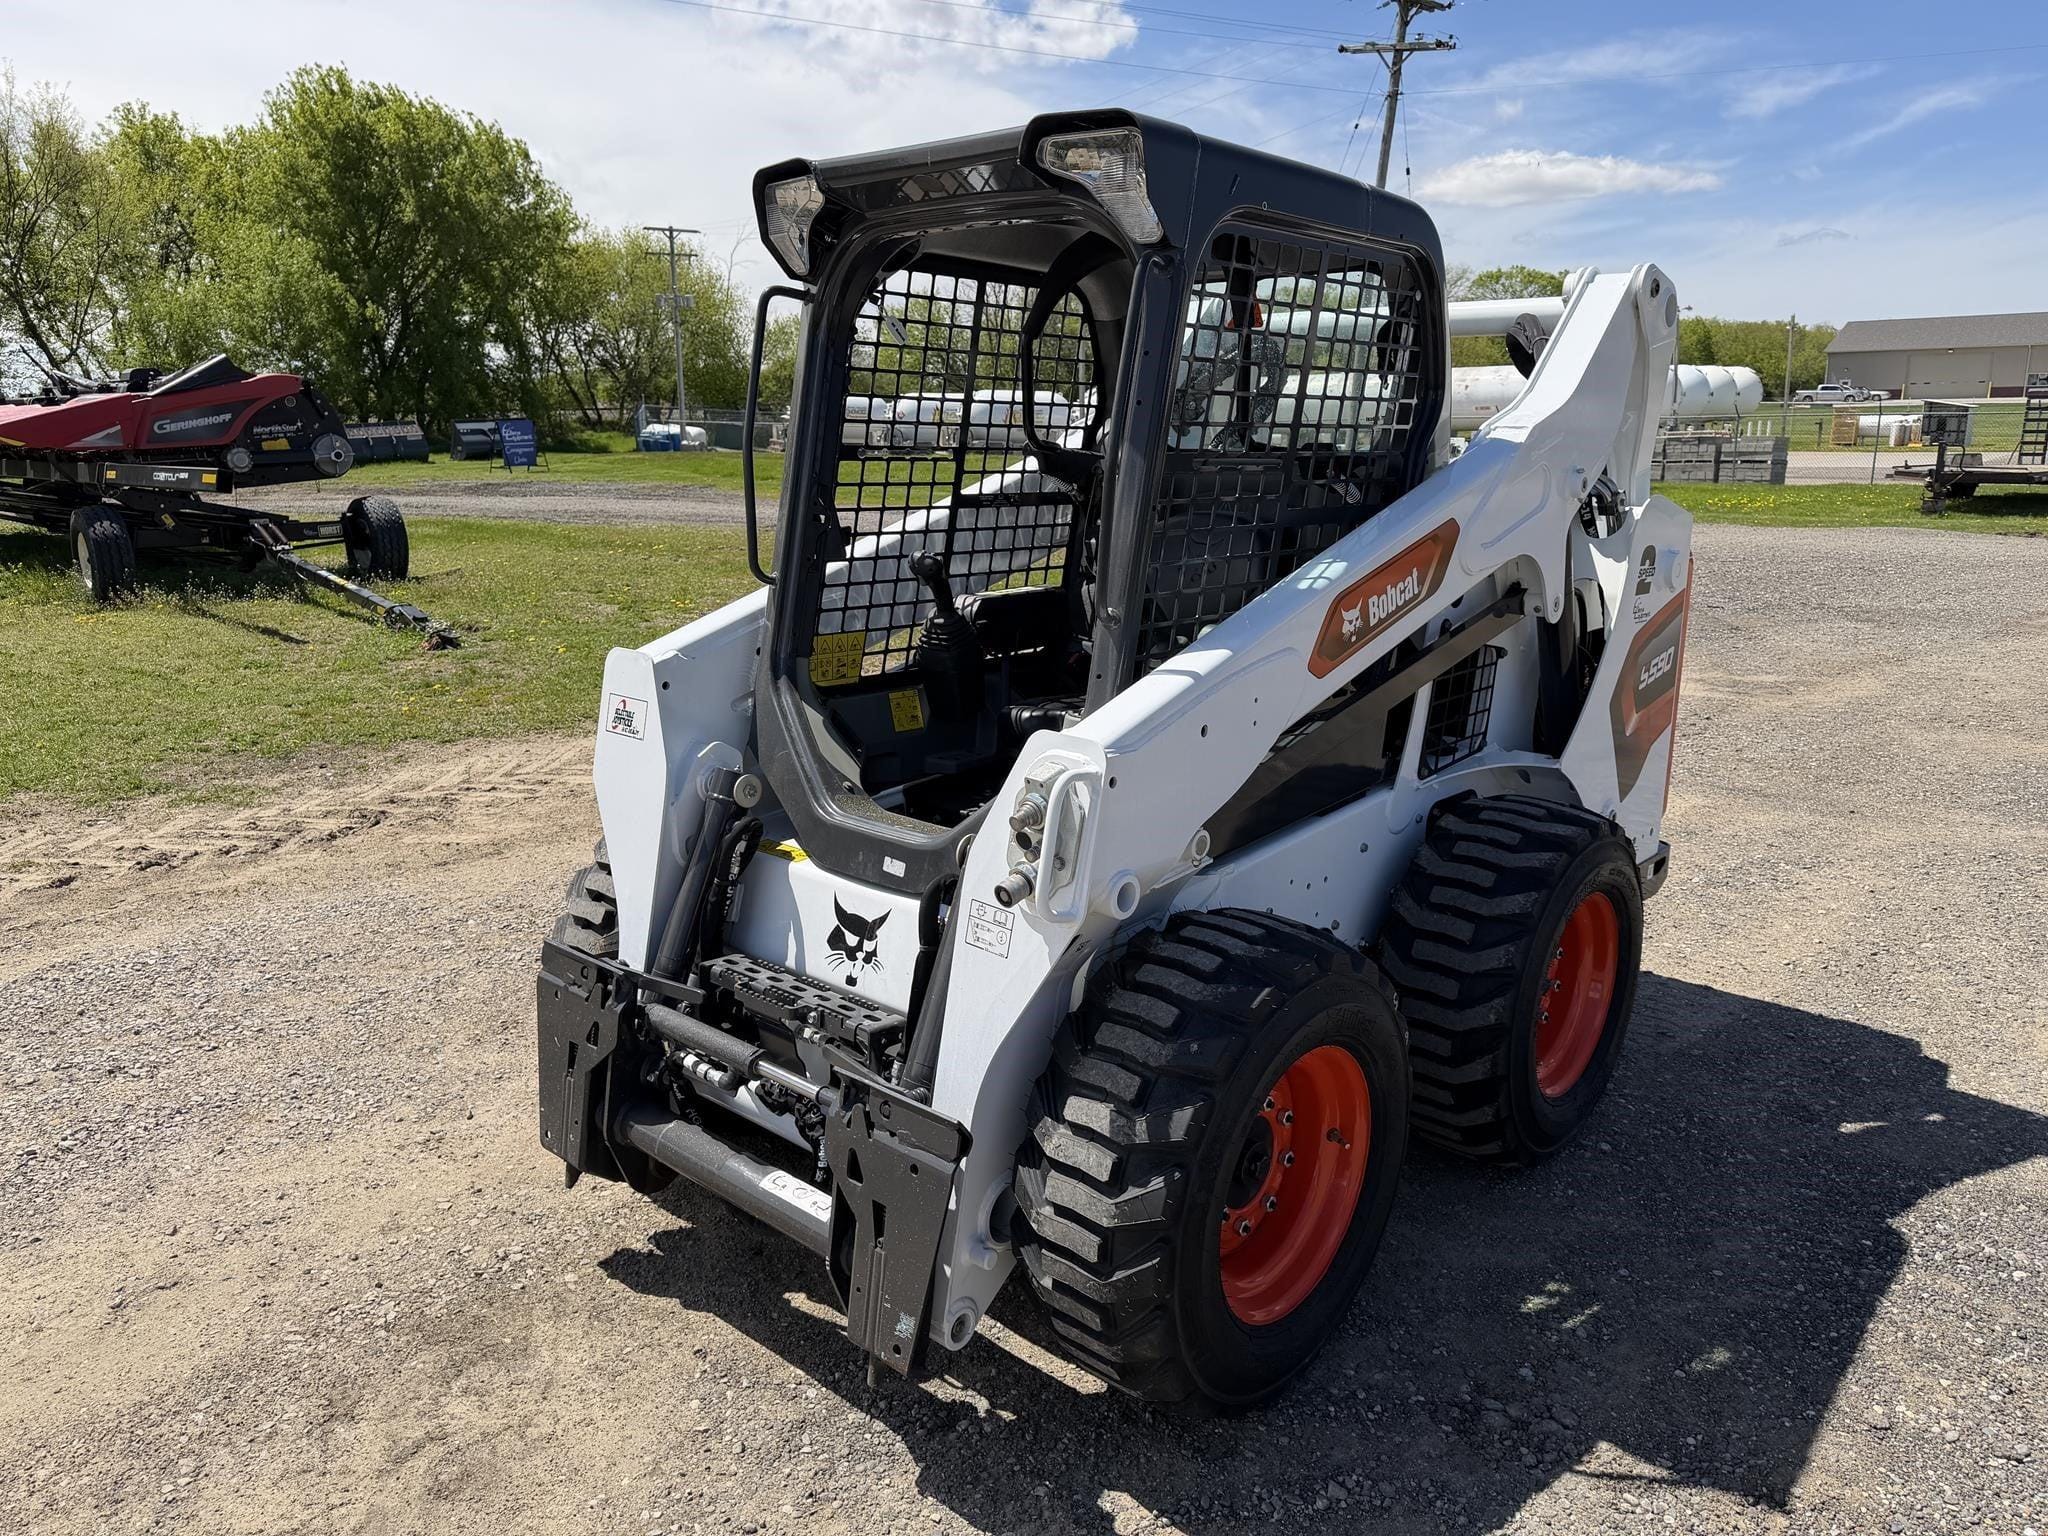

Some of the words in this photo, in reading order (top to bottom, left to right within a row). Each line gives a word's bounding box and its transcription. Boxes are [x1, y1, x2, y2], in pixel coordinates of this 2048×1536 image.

[153, 413, 232, 434] GERINGHOFF
[1637, 566, 1656, 579] SPEED
[1367, 567, 1419, 627] Bobcat
